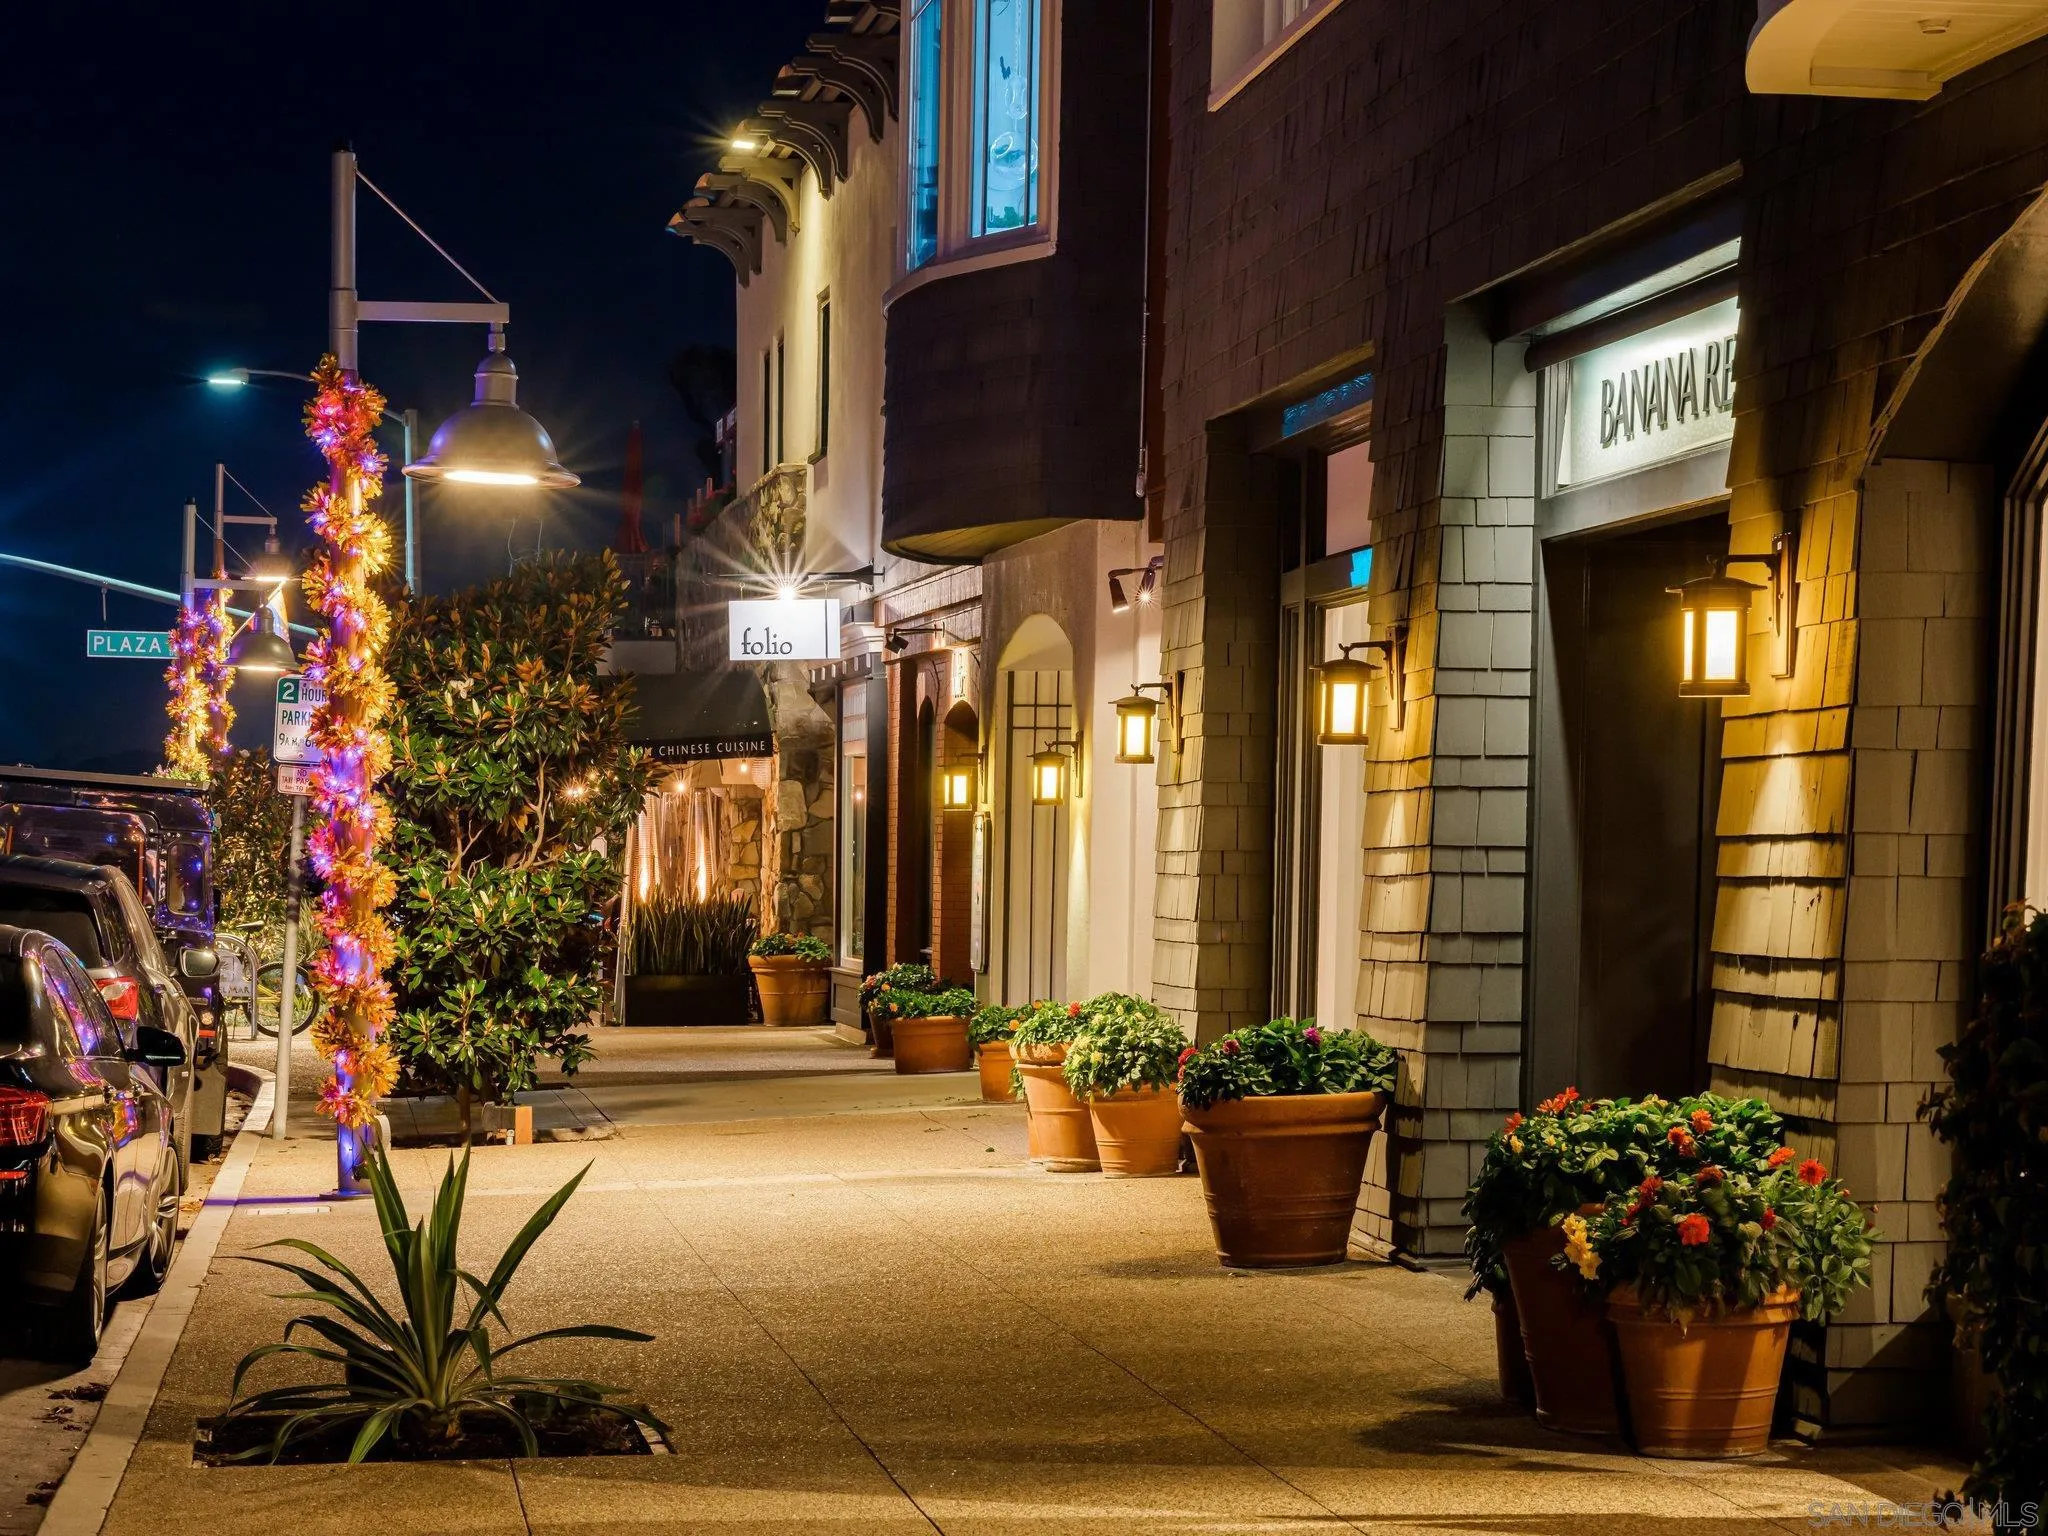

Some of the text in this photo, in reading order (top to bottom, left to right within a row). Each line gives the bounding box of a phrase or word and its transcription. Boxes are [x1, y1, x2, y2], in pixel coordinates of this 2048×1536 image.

[1600, 347, 1700, 449] BANANA
[93, 636, 162, 653] PLAZA
[741, 626, 793, 656] folio
[282, 682, 295, 700] 2
[659, 740, 765, 756] CHINESE CUISINE
